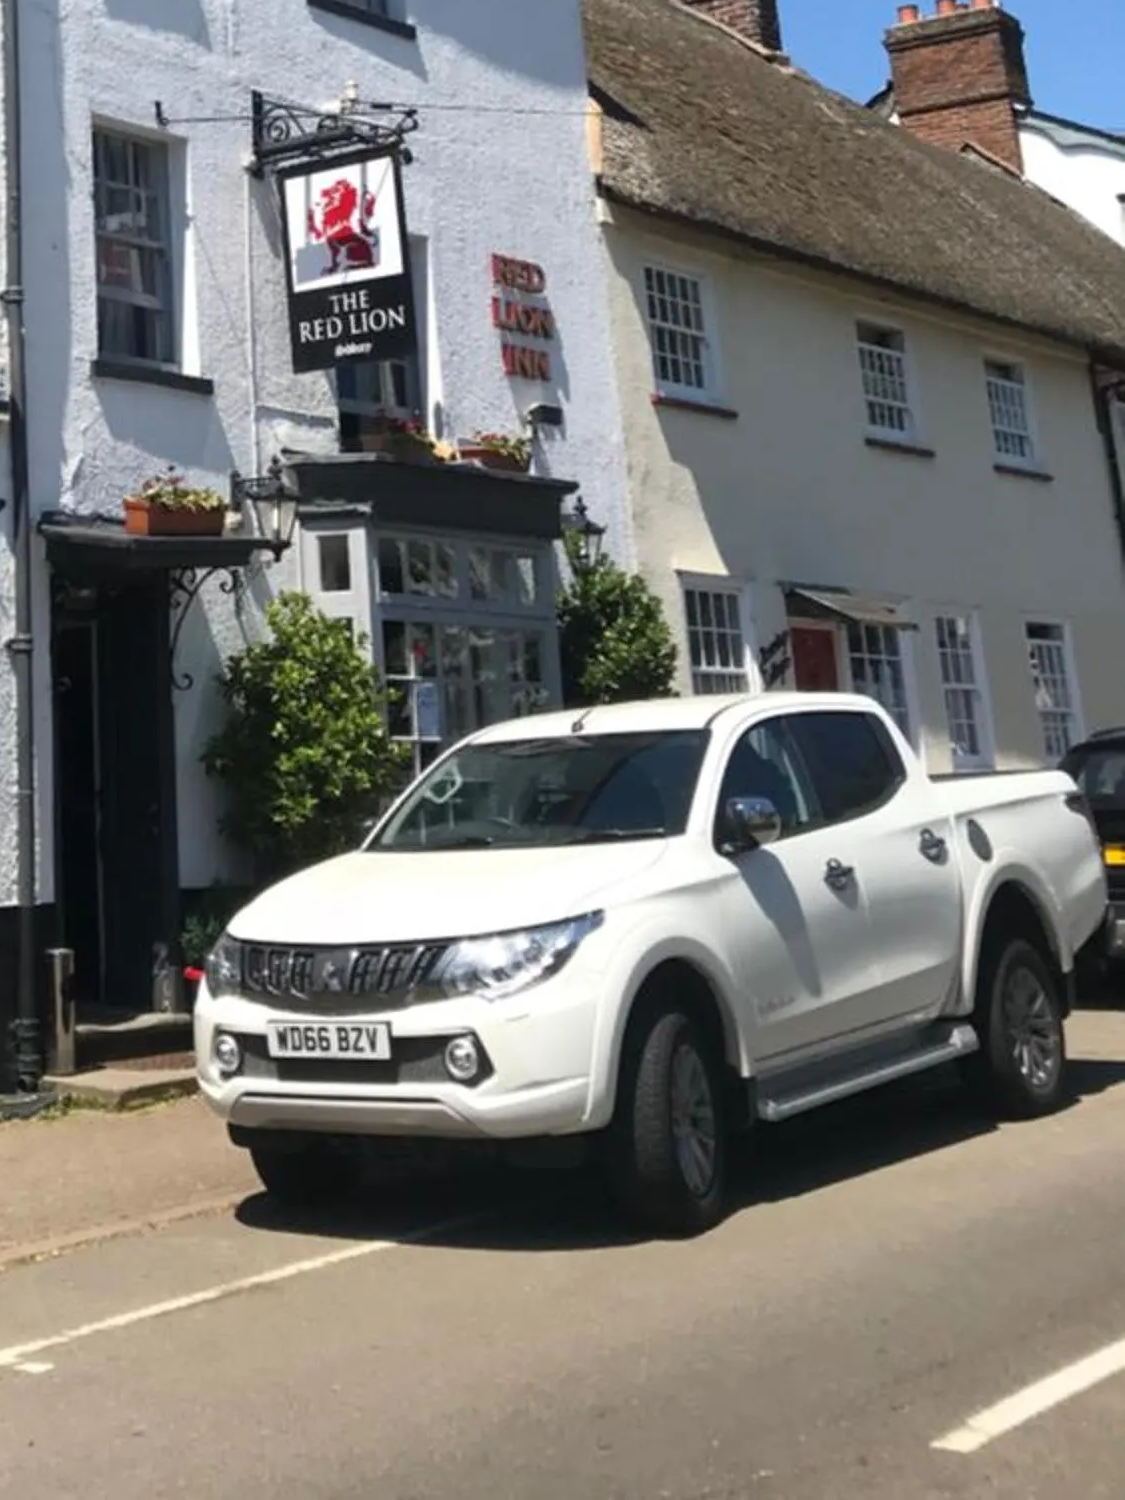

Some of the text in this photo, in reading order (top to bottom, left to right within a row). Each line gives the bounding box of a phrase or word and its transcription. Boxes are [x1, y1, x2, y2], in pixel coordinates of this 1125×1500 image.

[492, 252, 546, 293] RED
[328, 289, 370, 314] THE
[491, 296, 554, 341] LION
[299, 305, 405, 343] RED LION
[502, 343, 551, 382] INN
[276, 1026, 378, 1053] WD66 BZV
